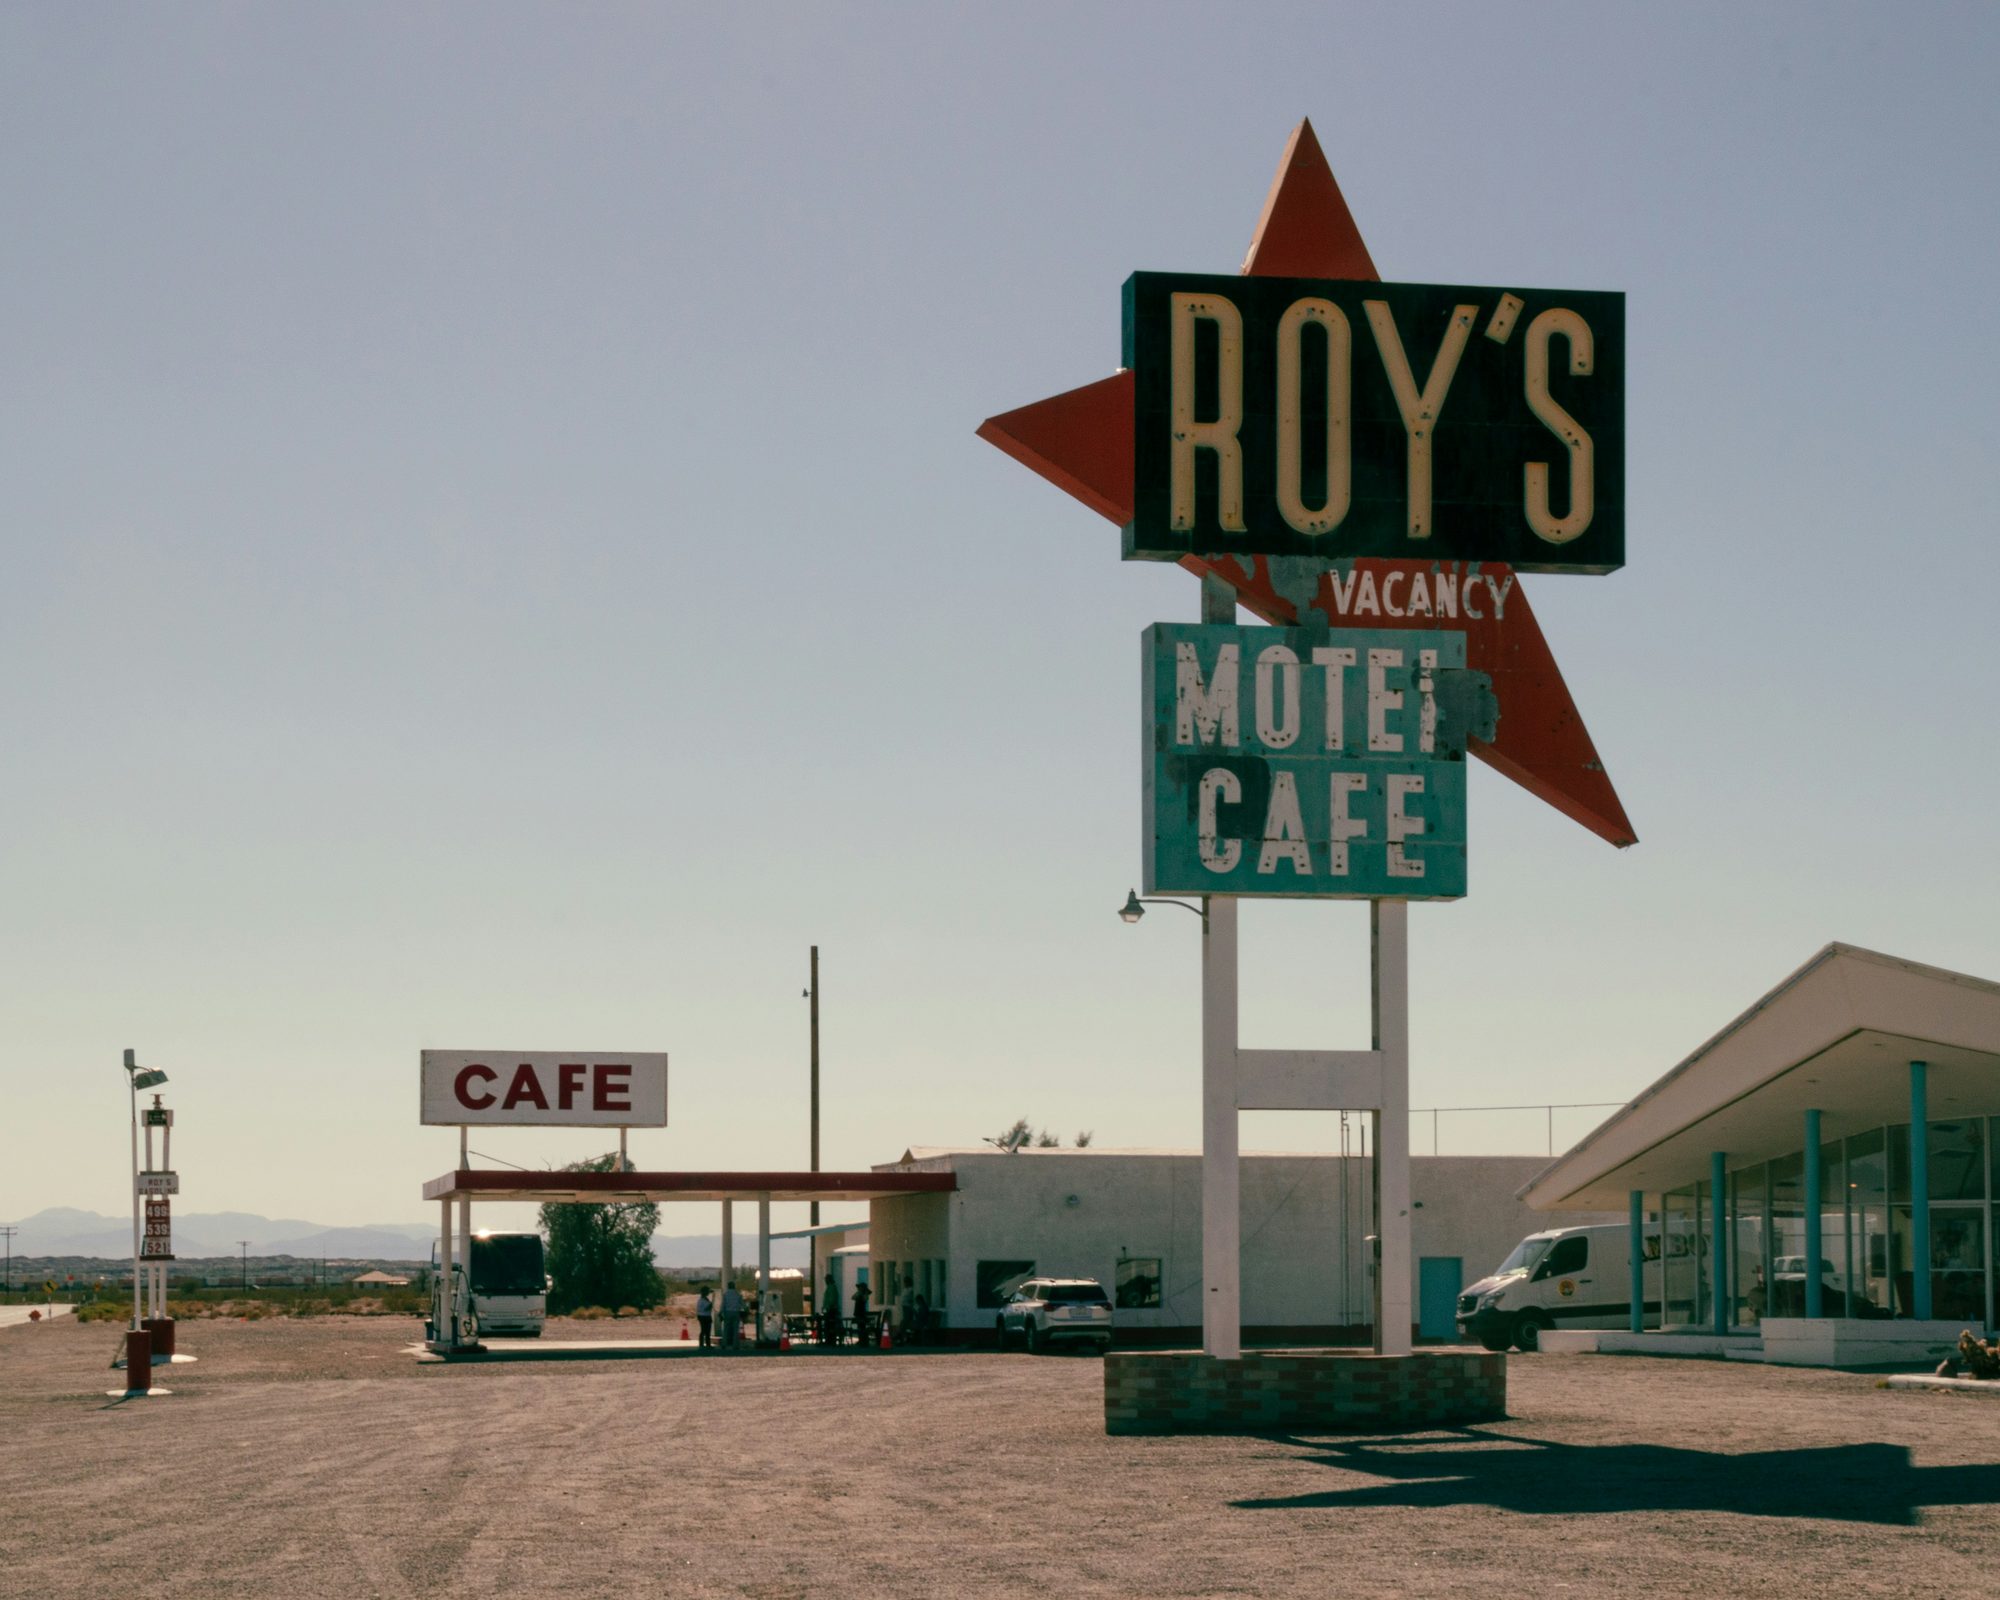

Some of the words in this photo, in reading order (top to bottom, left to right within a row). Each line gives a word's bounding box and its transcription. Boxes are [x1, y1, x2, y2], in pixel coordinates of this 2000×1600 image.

[1170, 291, 1594, 544] ROY'S
[1329, 568, 1515, 621] VACANCY
[1198, 767, 1426, 878] CAFE
[454, 1063, 632, 1111] CAFE
[138, 1187, 177, 1195] GASOLNE
[148, 1178, 171, 1186] ROYS
